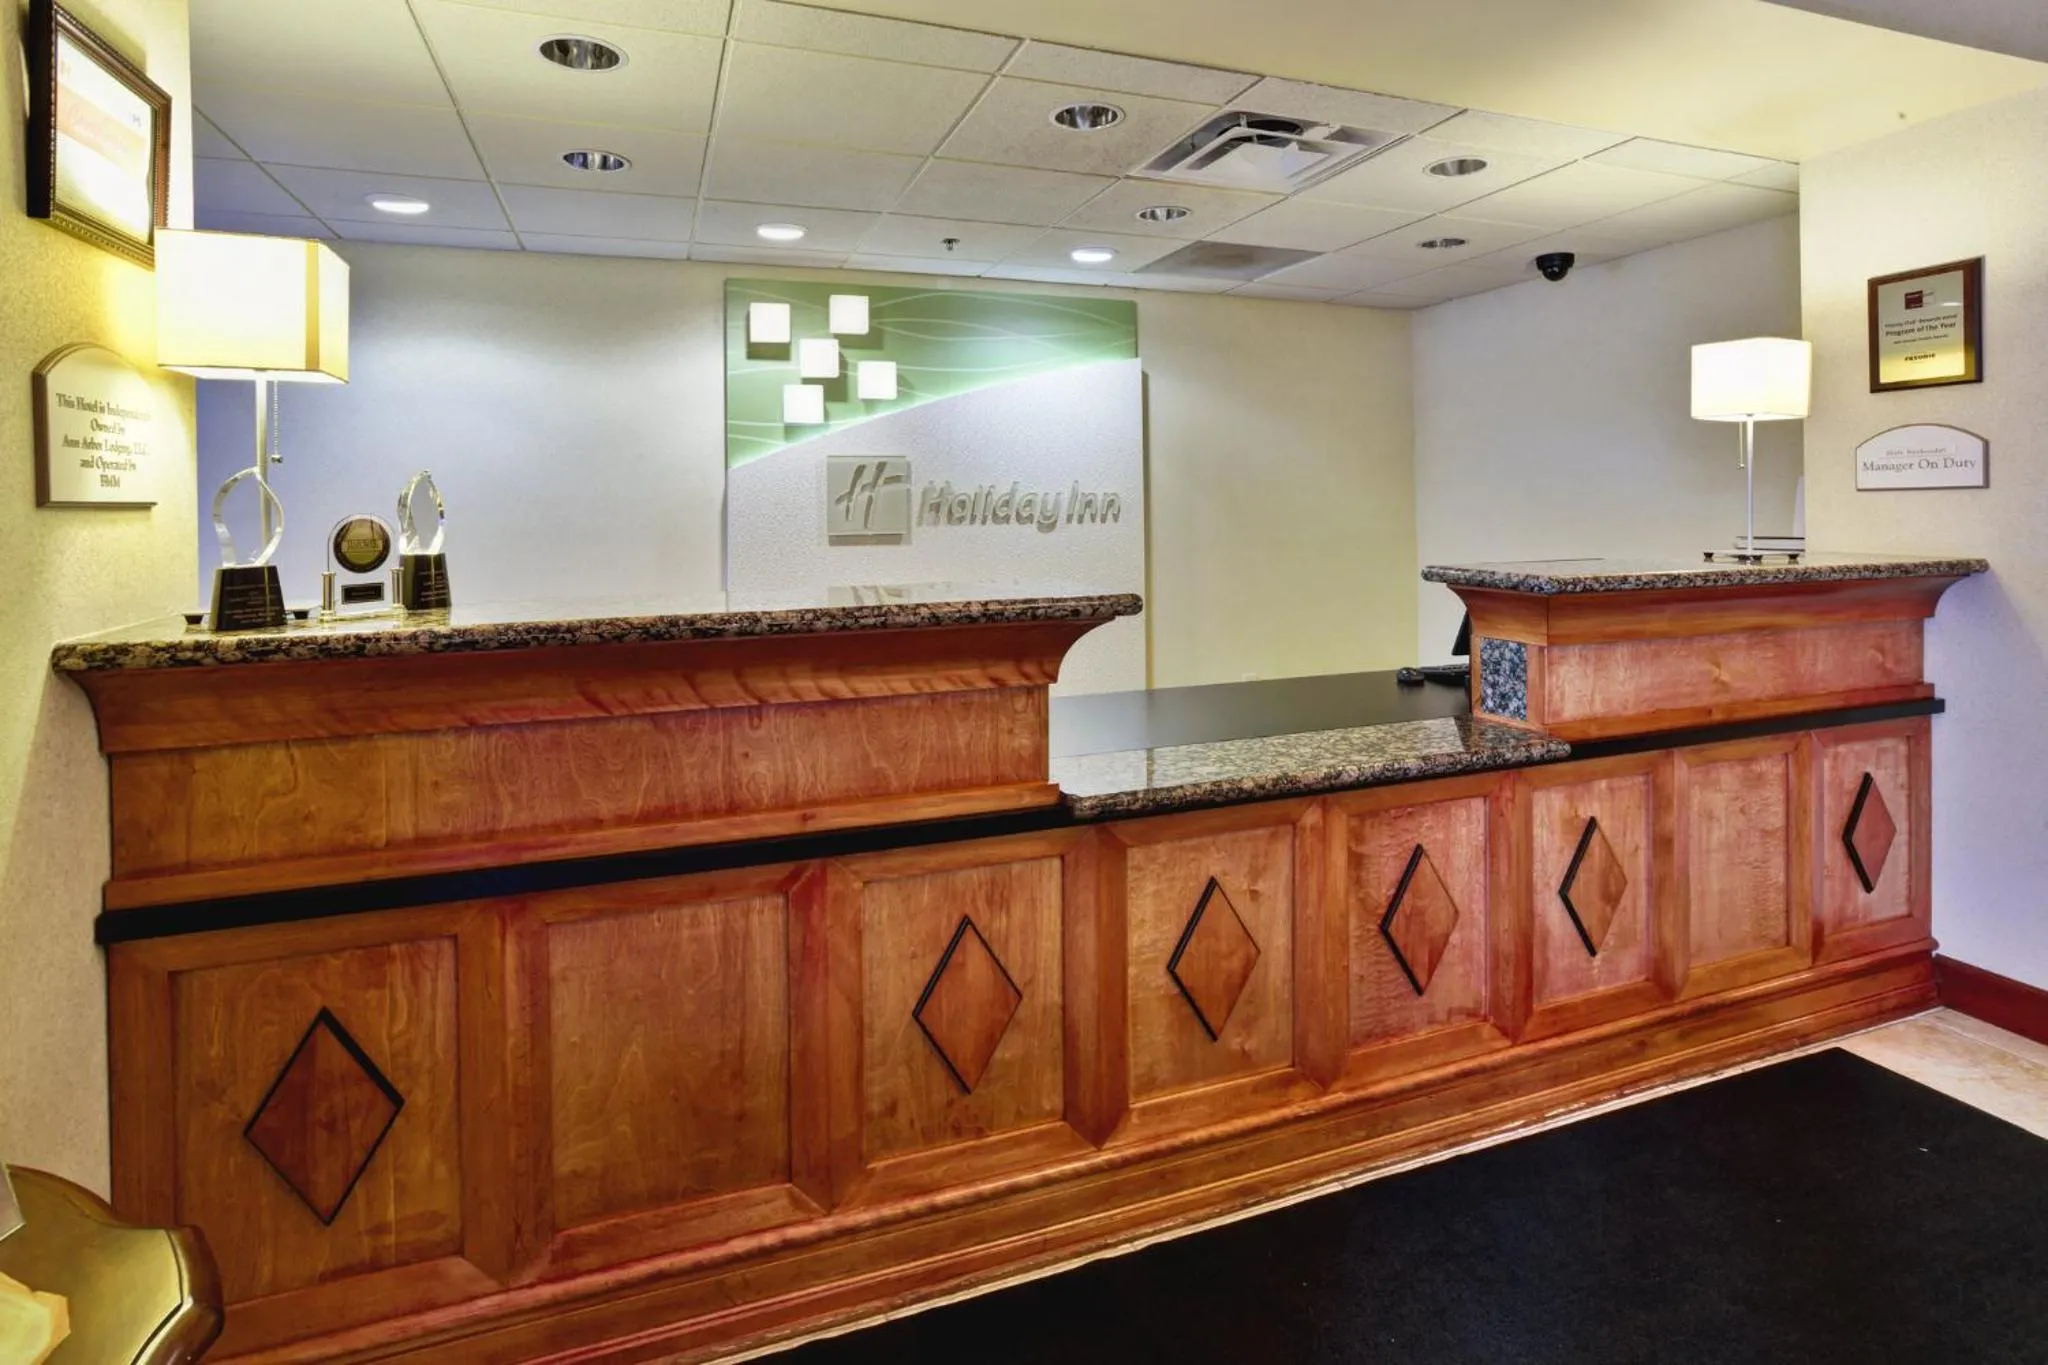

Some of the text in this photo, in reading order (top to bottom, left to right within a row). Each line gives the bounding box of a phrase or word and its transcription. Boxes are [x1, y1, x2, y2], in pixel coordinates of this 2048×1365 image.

[56, 392, 75, 409] This
[76, 396, 98, 413] Hotel
[99, 401, 106, 415] is
[90, 418, 116, 434] Owned
[62, 434, 80, 449] Ann
[81, 435, 103, 451] Arbor
[80, 454, 95, 469] and
[96, 456, 127, 472] Operated
[1861, 457, 1977, 473] Manager On Duty
[917, 479, 1063, 533] Holiday
[1066, 479, 1122, 525] Inn
